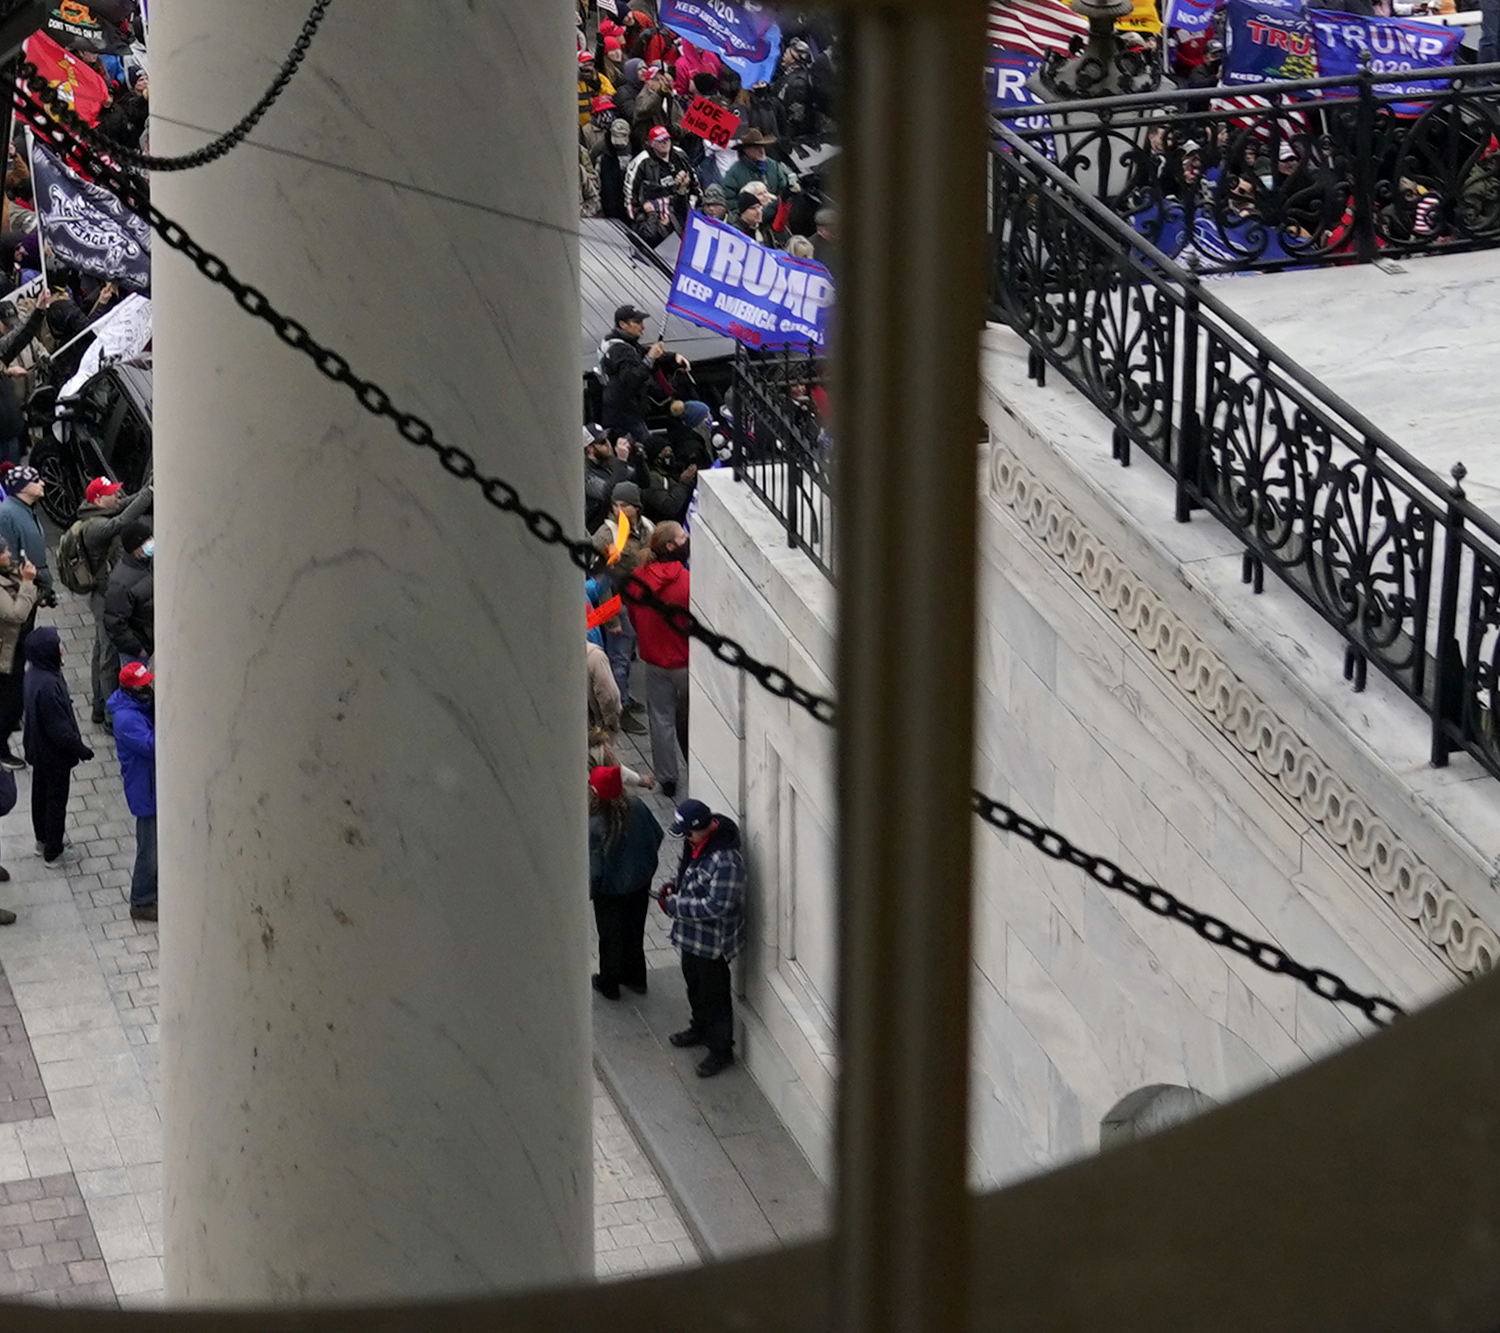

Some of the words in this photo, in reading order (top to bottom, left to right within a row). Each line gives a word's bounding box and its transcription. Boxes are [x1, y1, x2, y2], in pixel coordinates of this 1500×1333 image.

[675, 0, 700, 15] KEEP
[1316, 23, 1444, 62] TRUMP
[1230, 72, 1264, 82] KEEP
[1357, 58, 1412, 74] 020
[1372, 84, 1404, 95] ERICA
[693, 100, 723, 123] JOE
[709, 124, 731, 146] GO
[690, 217, 836, 325] TRUMP
[676, 273, 713, 303] KEEP
[715, 293, 778, 332] AMERICA
[728, 321, 762, 345] 2020
